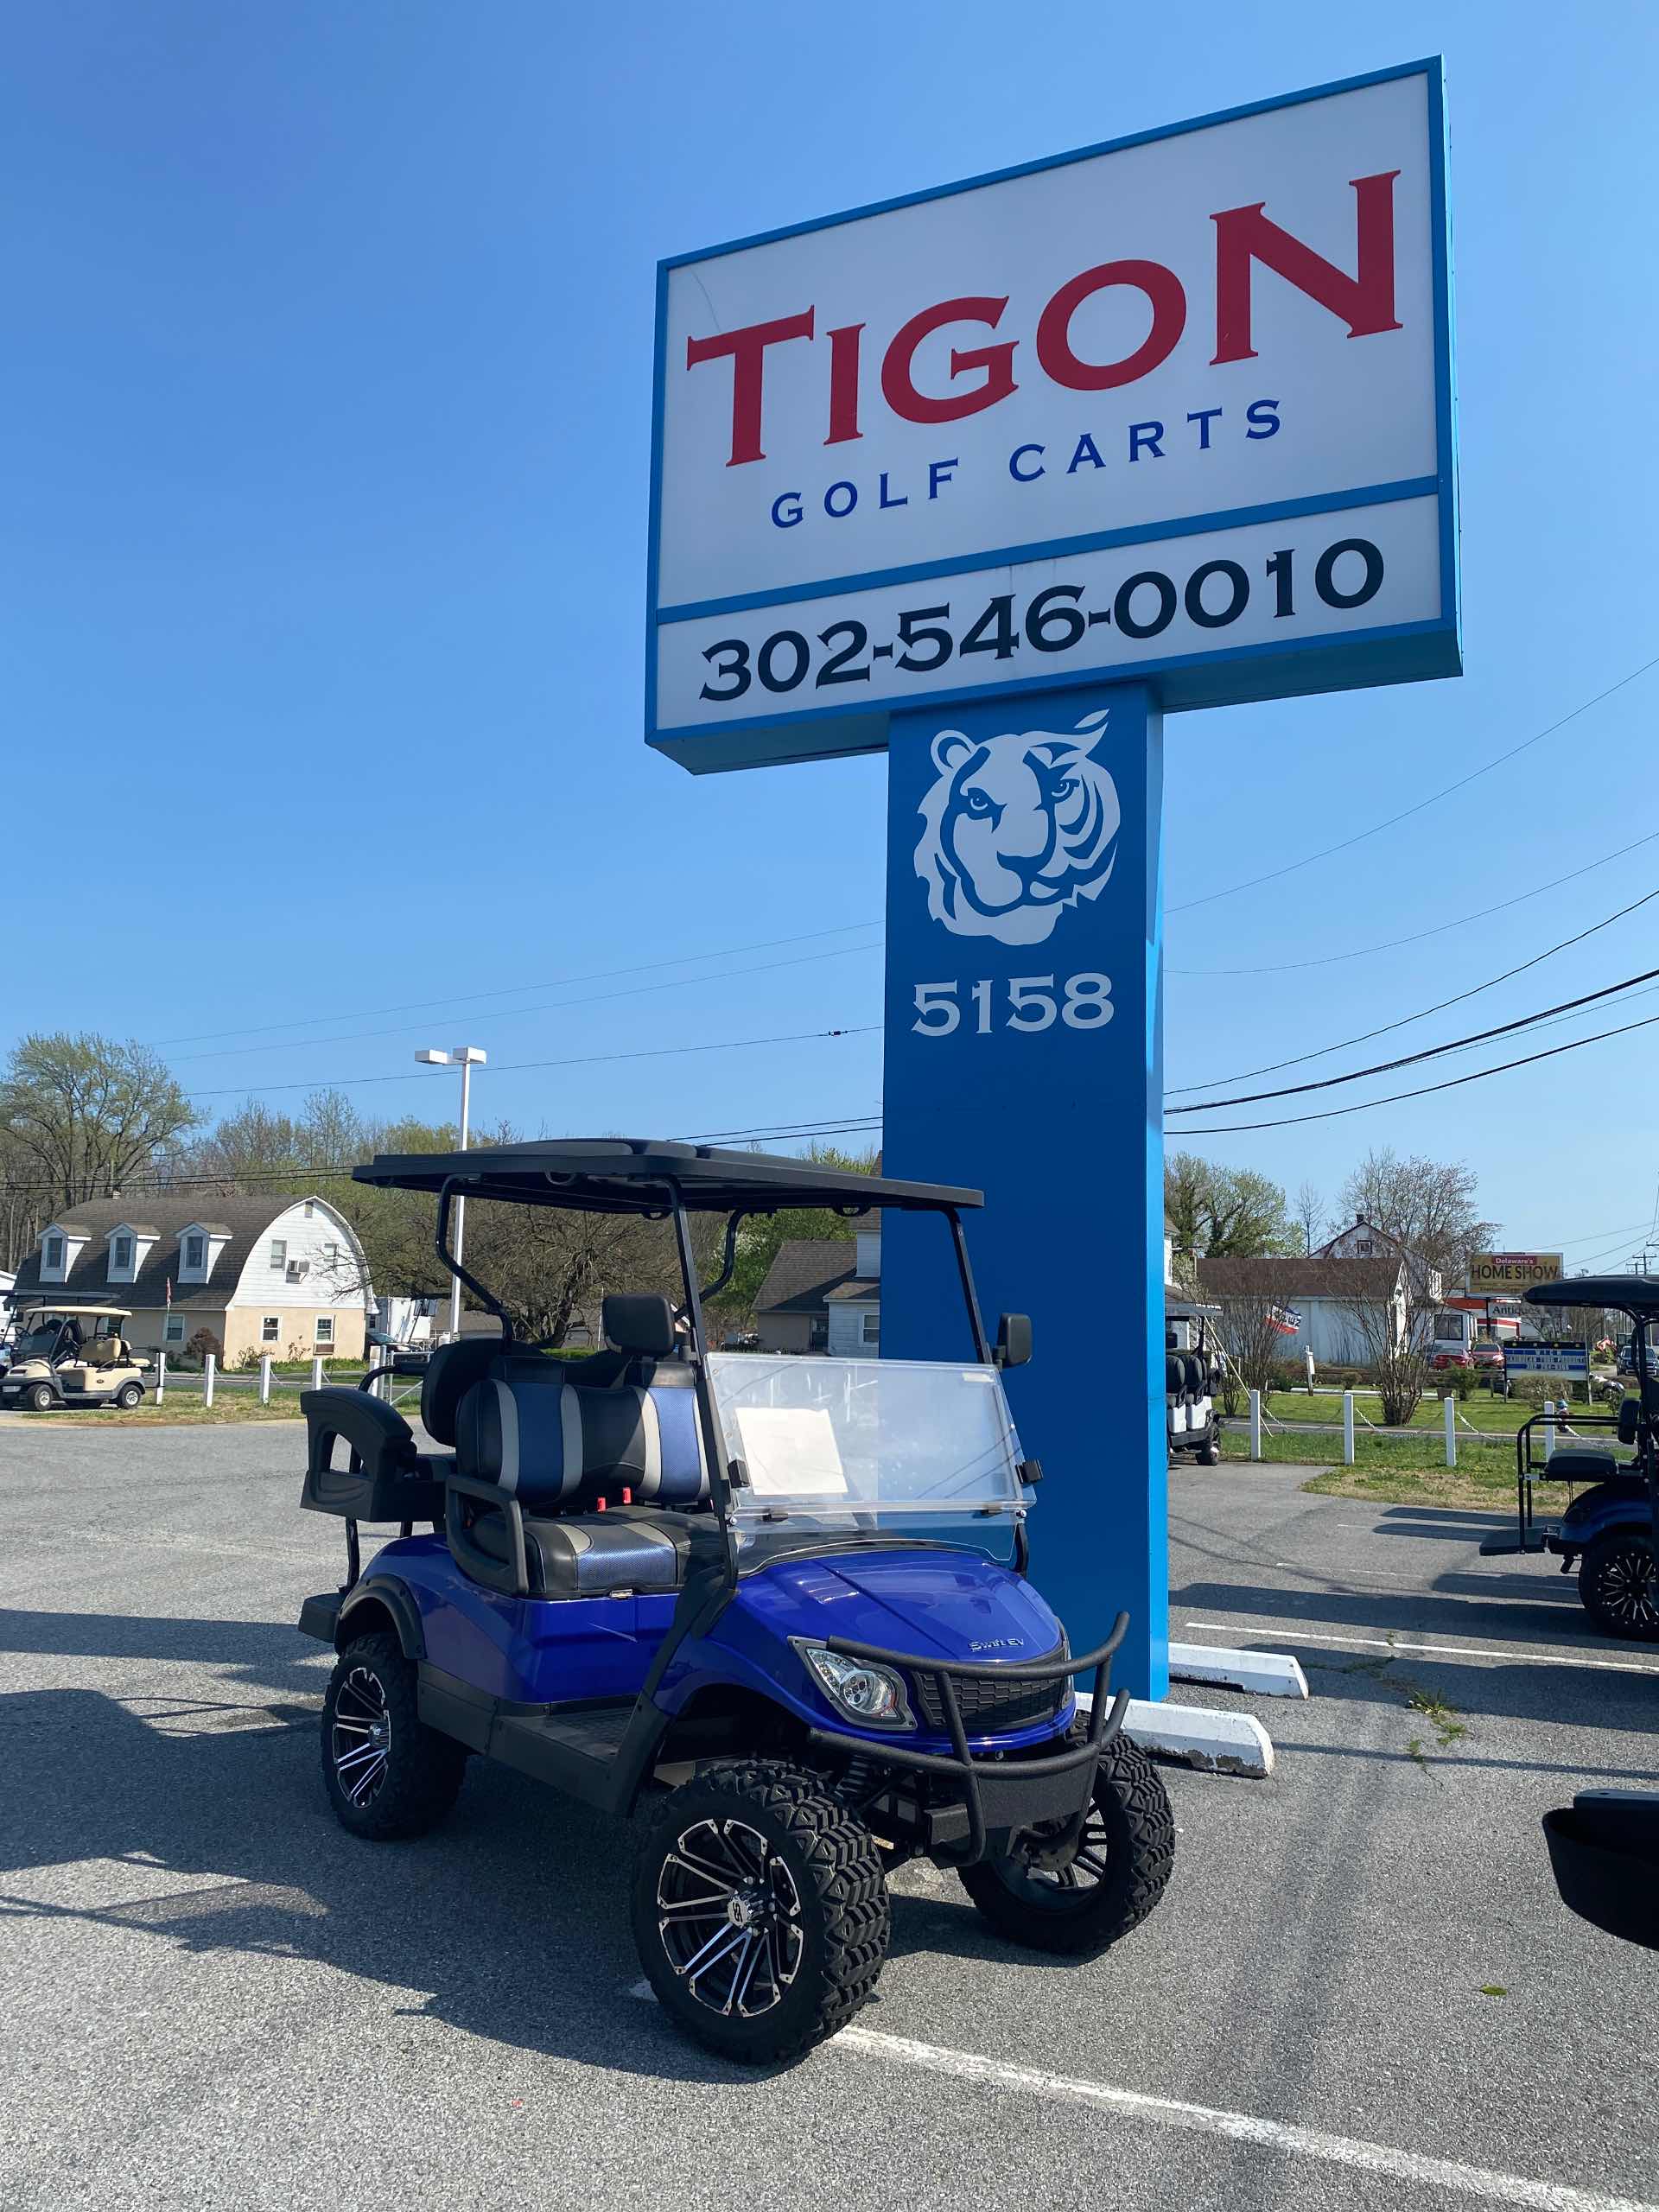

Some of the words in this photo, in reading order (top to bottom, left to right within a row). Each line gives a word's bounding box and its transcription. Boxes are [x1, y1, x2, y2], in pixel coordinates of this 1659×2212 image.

[687, 169, 1403, 467] TIGON
[771, 457, 959, 529] GOLF
[1008, 398, 1281, 484] CARTS
[698, 537, 1385, 702] 302-546-0010
[911, 972, 1115, 1037] 5158
[1471, 1264, 1512, 1280] HOME
[1515, 1265, 1558, 1280] SHOW
